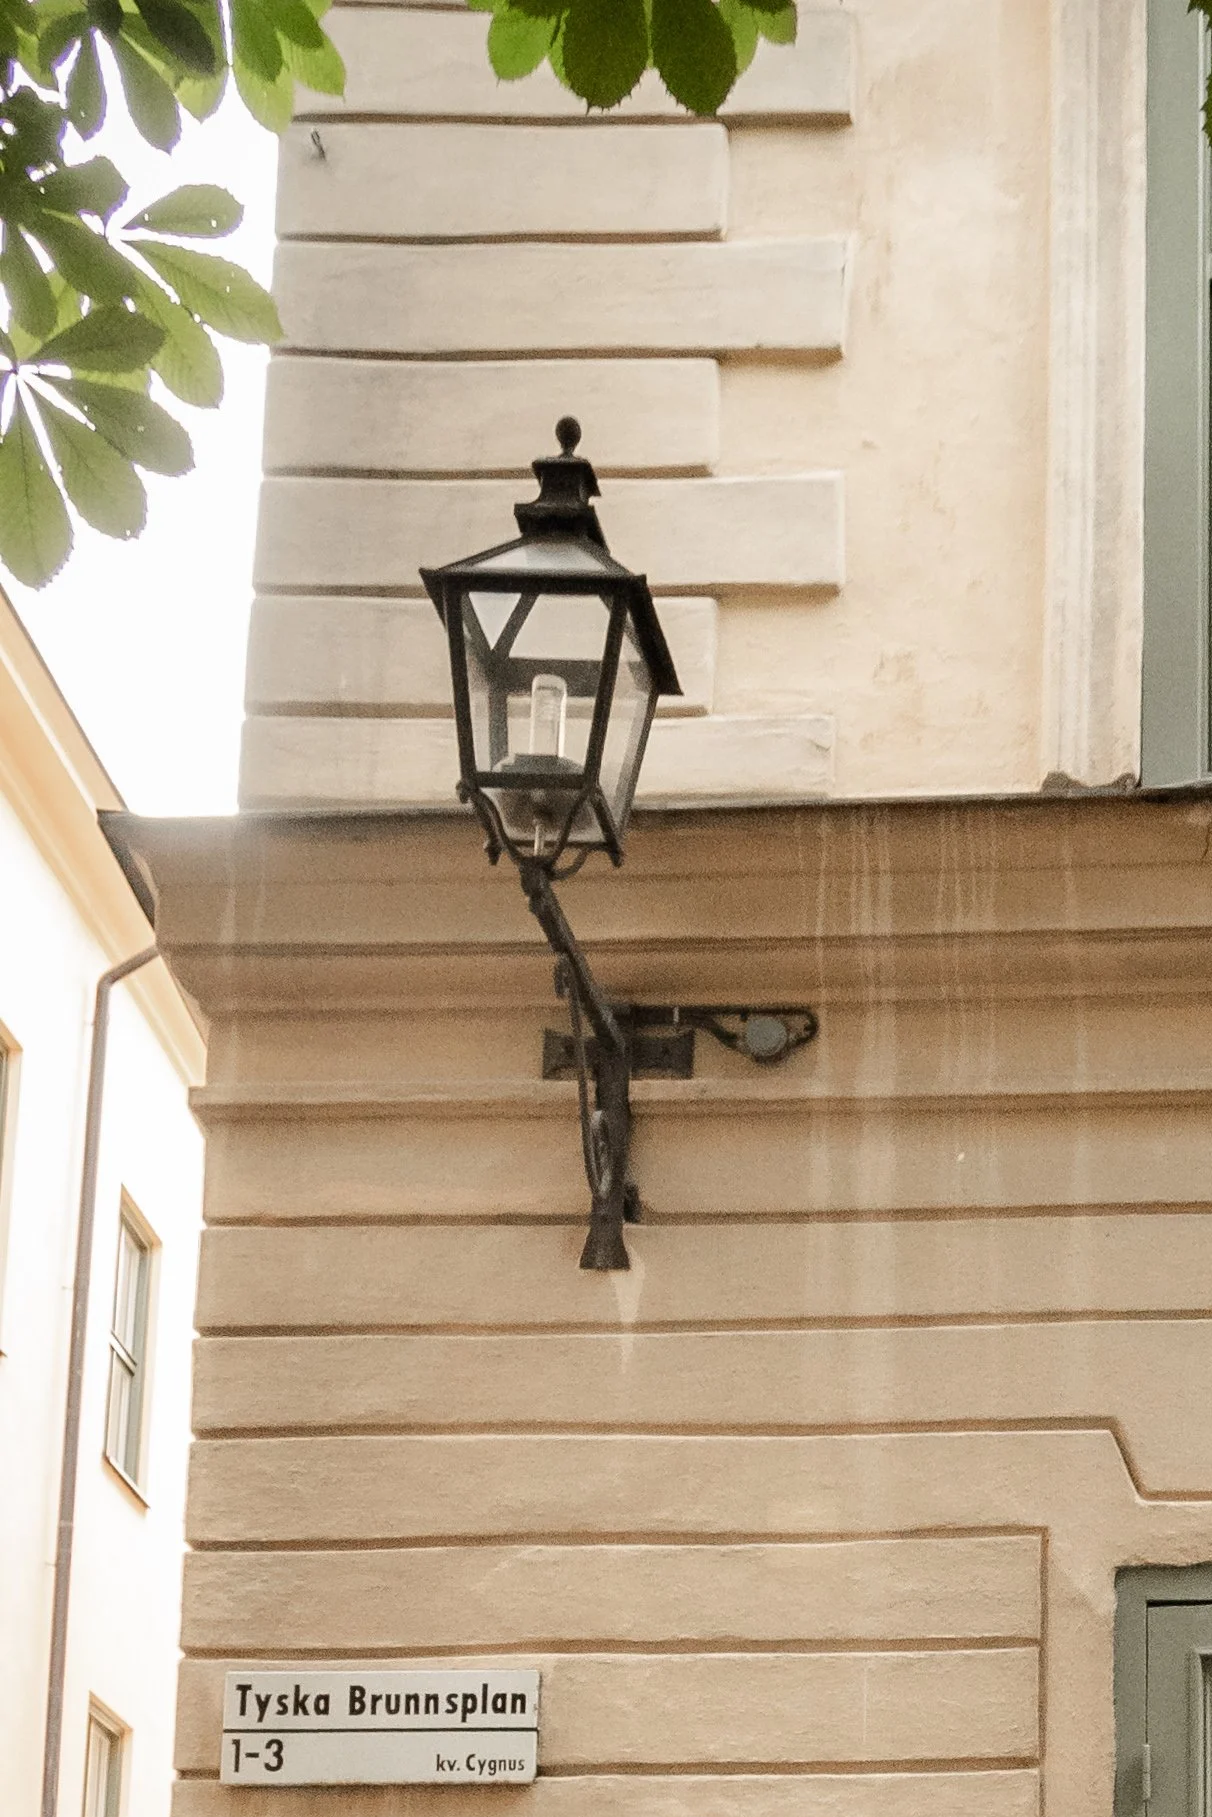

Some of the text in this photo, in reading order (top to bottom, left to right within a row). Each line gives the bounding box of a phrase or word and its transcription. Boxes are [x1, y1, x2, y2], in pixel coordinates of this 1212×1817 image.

[235, 1682, 527, 1723] Tyska Brunnsplan
[231, 1738, 285, 1773] 1-3
[435, 1753, 526, 1776] kv. Cygnus
